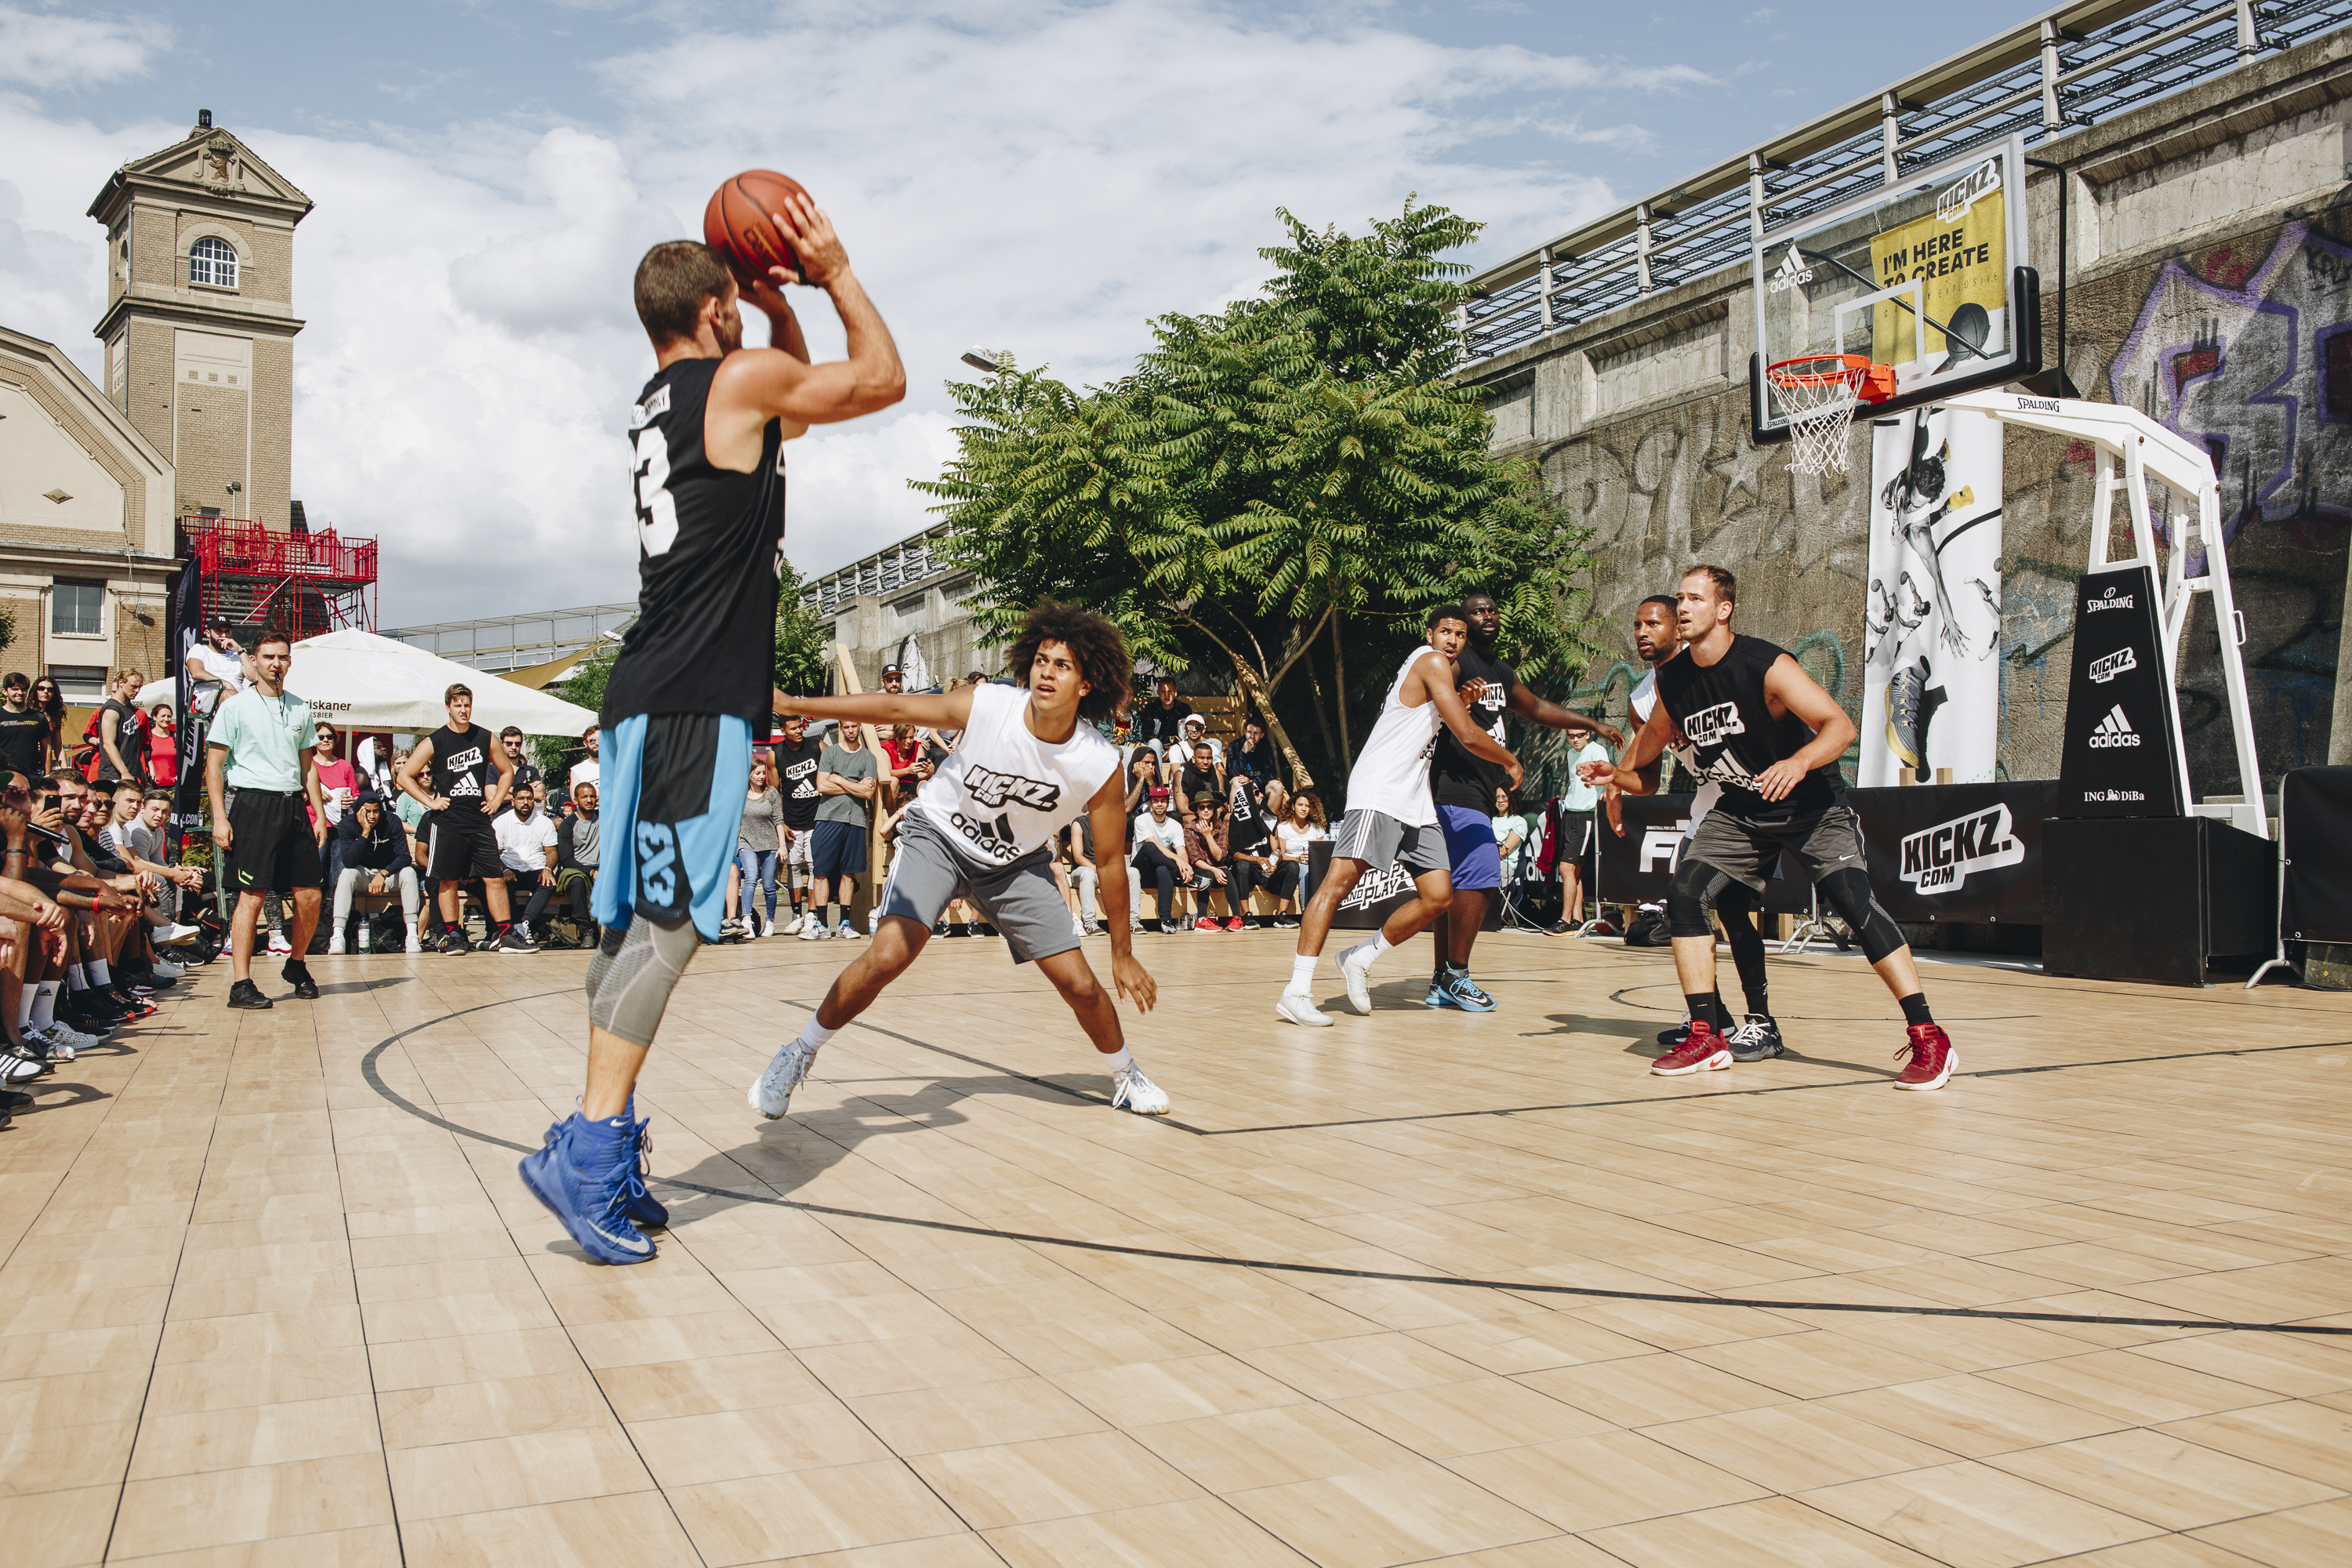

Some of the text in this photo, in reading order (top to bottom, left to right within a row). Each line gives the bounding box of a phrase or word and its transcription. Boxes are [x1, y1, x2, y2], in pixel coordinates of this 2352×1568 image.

[1948, 202, 1965, 220] COM
[1883, 227, 1964, 276] I'M HERE
[1911, 242, 1990, 283] CREATE
[1769, 269, 1813, 294] adidas
[2017, 397, 2060, 413] SPALDING
[1766, 416, 1790, 430] SPALDING
[2087, 594, 2134, 614] SPALDING
[2090, 649, 2132, 677] KICKZ.
[2097, 671, 2111, 681] COM
[1698, 730, 1717, 743] COM
[2089, 731, 2141, 749] adidas
[449, 786, 482, 797] adidas
[792, 789, 819, 799] adidas
[974, 788, 1004, 805] COM
[2084, 790, 2145, 802] ING DiBa
[950, 812, 1021, 861] adidas
[1904, 809, 2013, 875] KICKZ.
[1921, 866, 1955, 888] COM
[1362, 878, 1399, 907] PLAY
